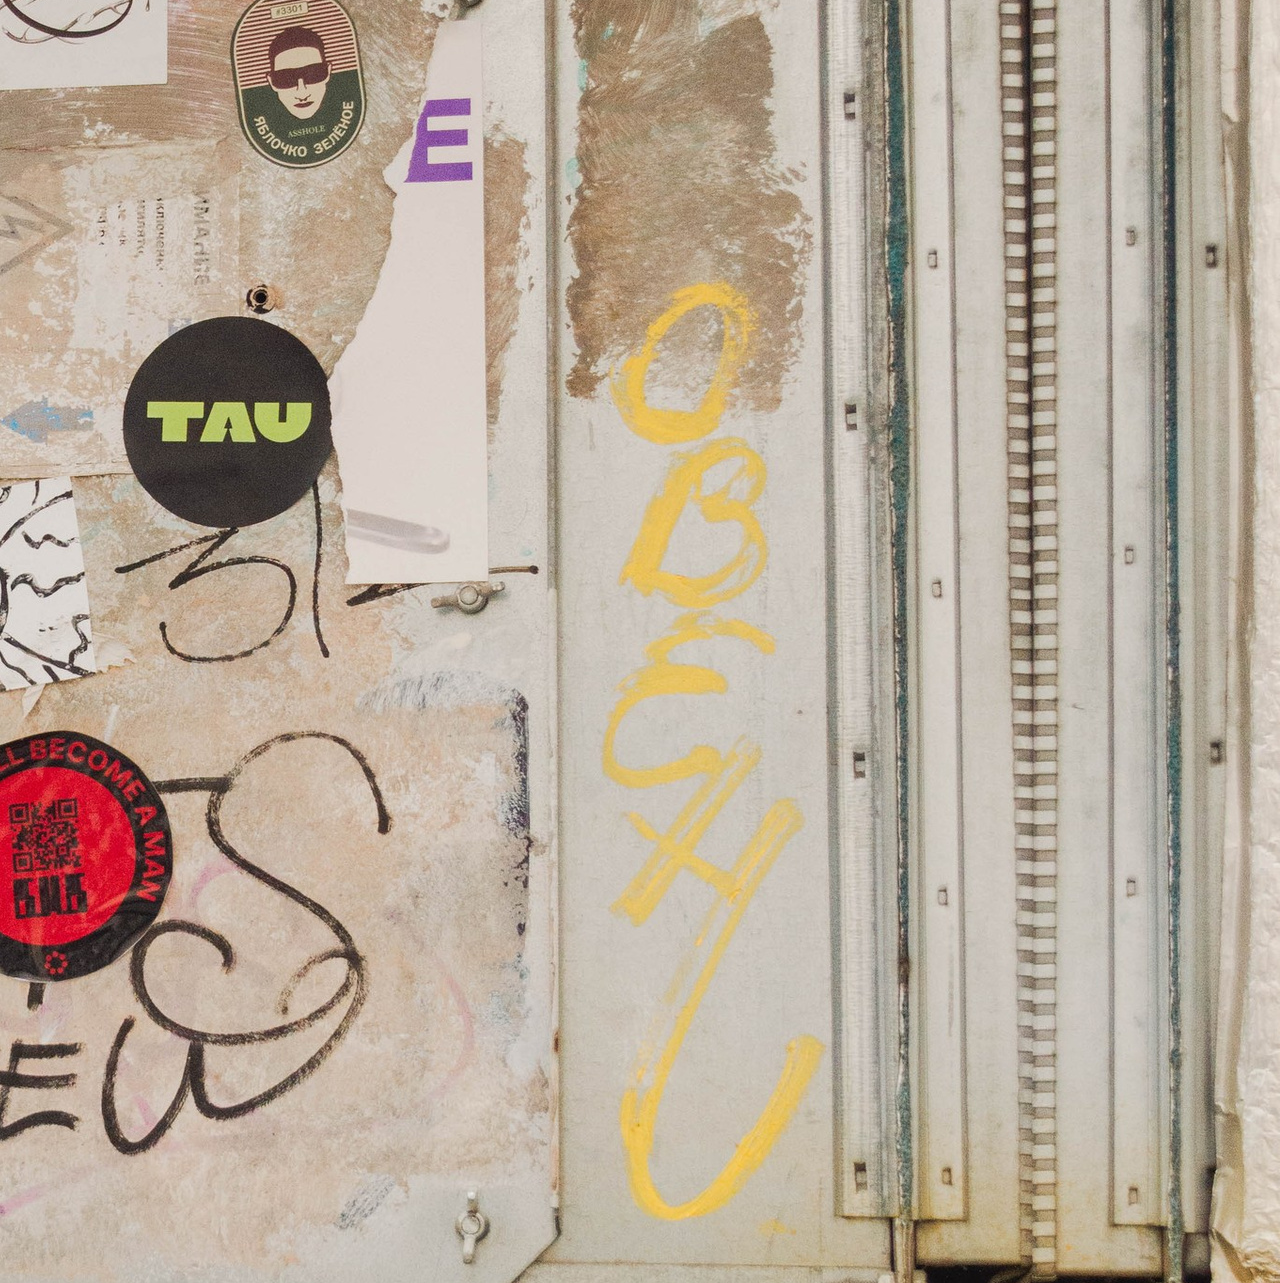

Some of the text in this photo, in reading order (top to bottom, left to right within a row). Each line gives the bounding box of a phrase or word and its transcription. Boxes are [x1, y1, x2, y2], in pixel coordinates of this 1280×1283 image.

[275, 4, 304, 16] #3301
[253, 100, 355, 158] ЯБЛОЧКО ЗЕЛЁНОЕ
[287, 125, 326, 139] ASSHOLE
[146, 401, 313, 443] TAU
[29, 738, 147, 802] BECOME
[134, 805, 158, 827] A
[136, 830, 167, 903] MAN
